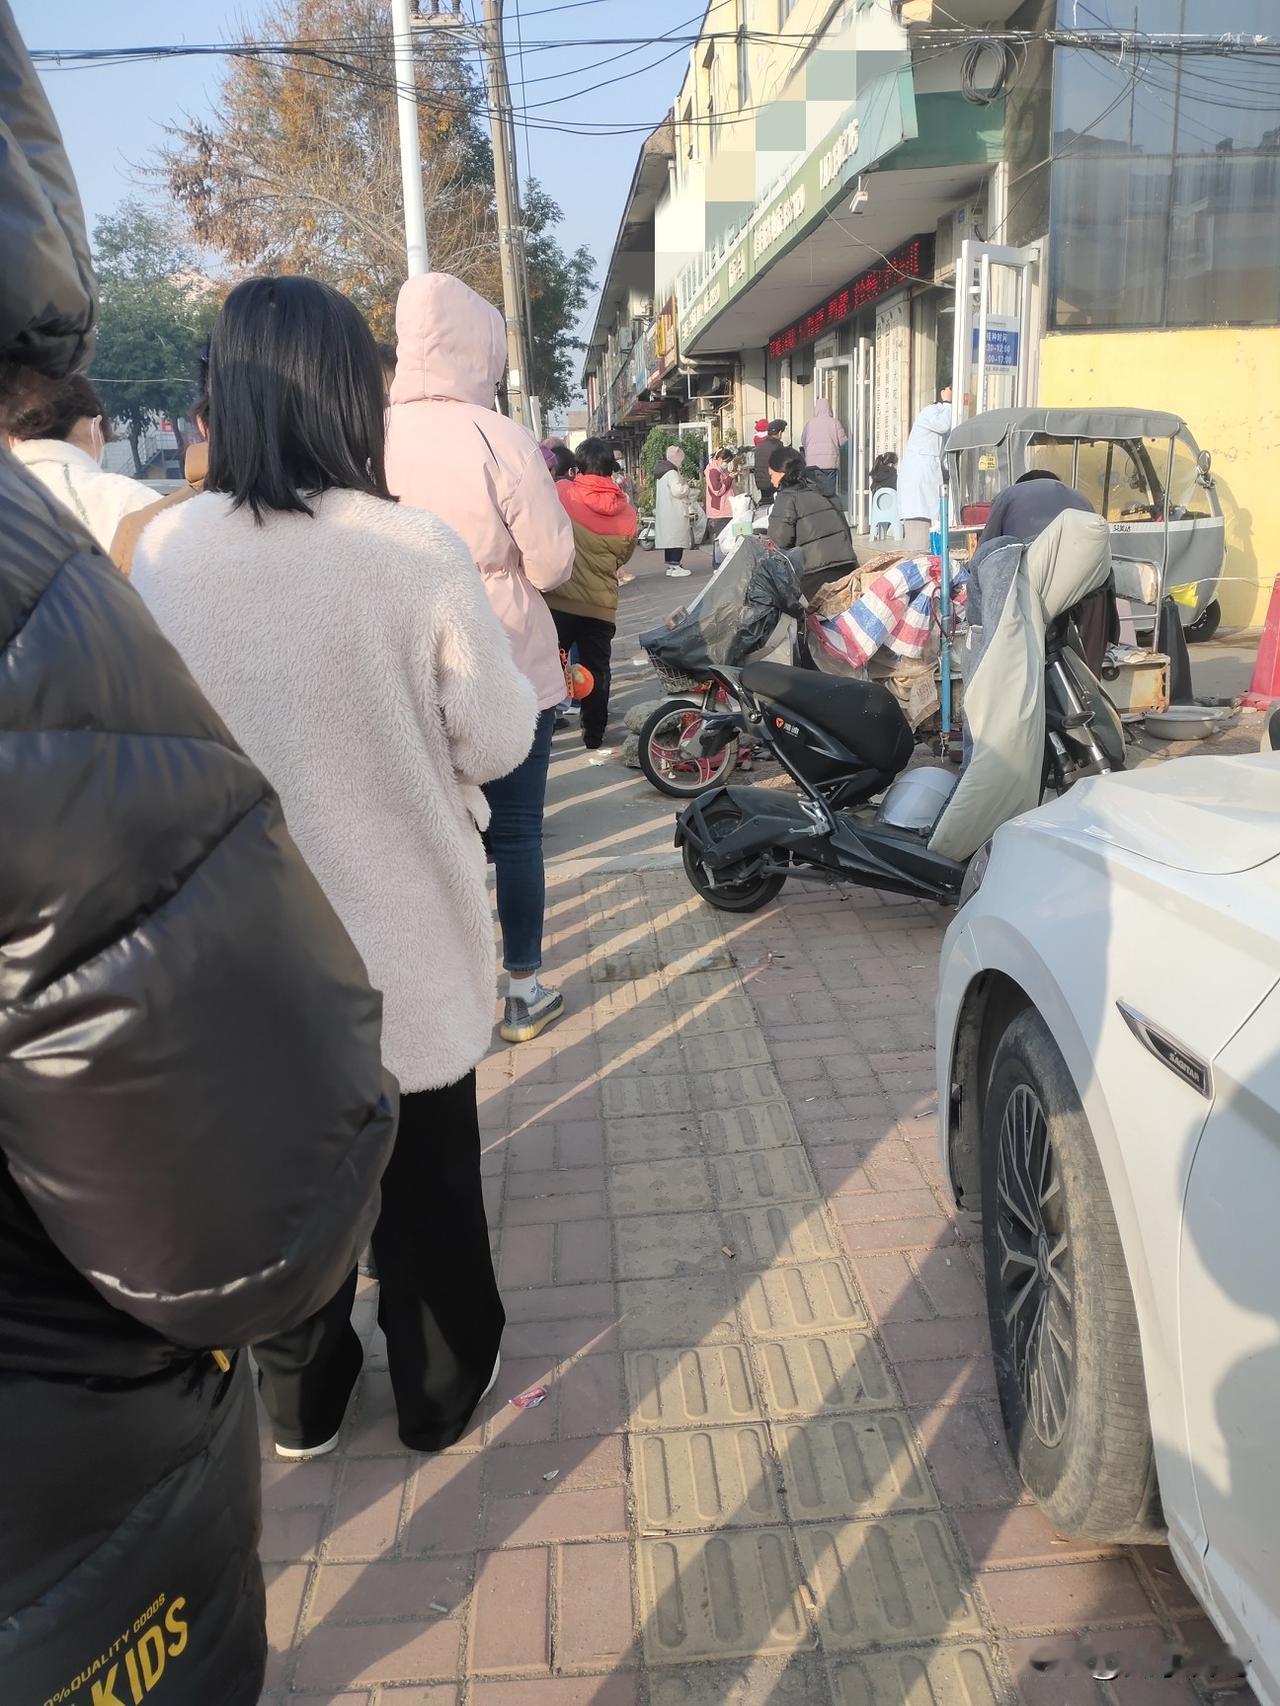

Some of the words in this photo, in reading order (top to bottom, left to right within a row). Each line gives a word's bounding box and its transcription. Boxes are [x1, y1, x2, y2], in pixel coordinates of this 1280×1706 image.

[1168, 1052, 1201, 1082] SAGITAR
[133, 1593, 166, 1633] GOODS
[91, 1597, 188, 1706] KIDS
